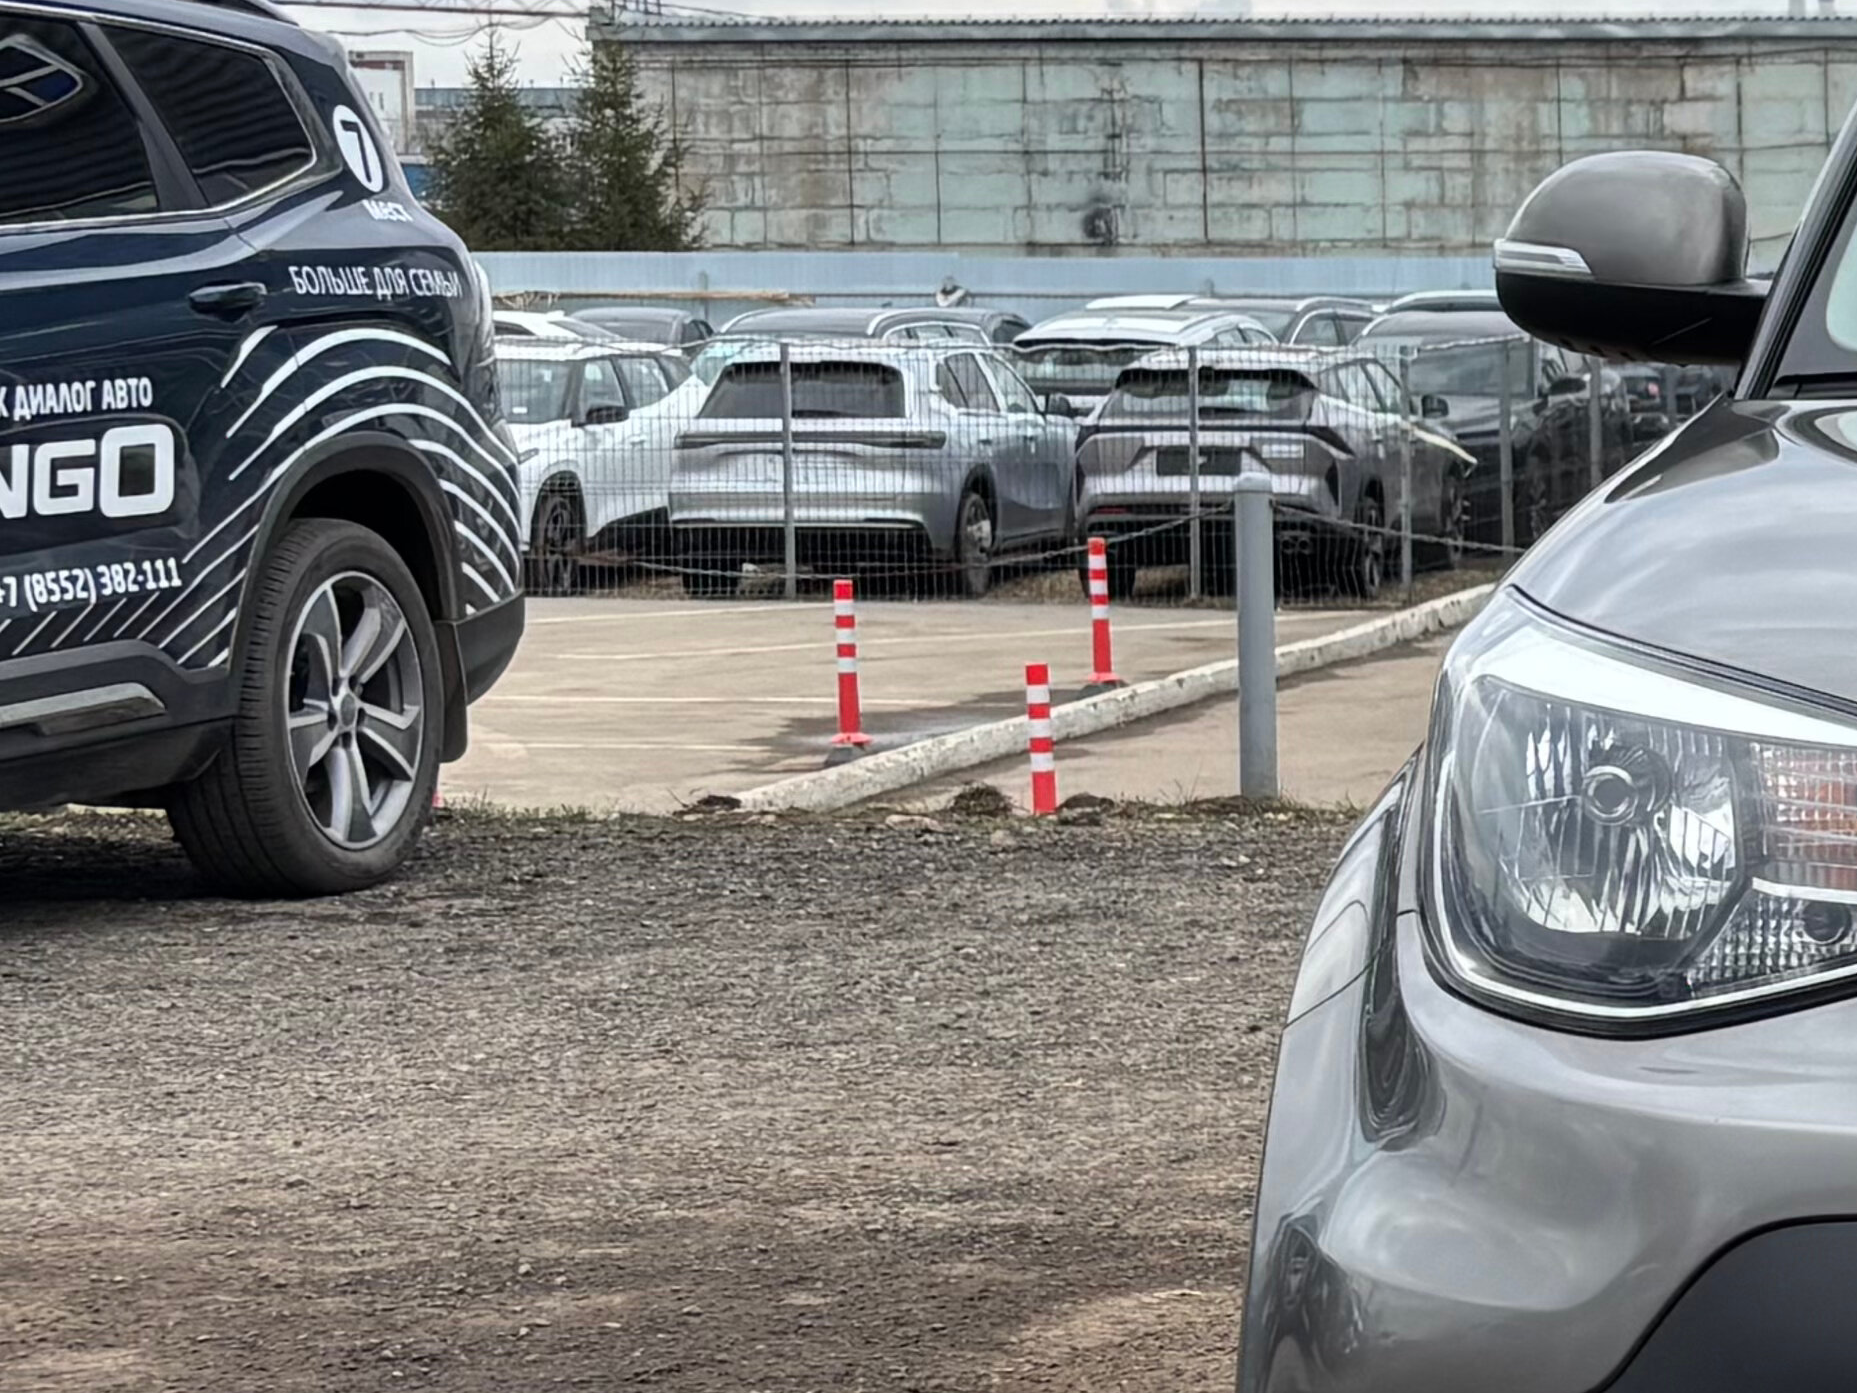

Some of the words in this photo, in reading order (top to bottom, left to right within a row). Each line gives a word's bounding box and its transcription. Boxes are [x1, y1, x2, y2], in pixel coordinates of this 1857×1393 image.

[340, 120, 372, 182] 7
[288, 266, 372, 295] БОЛЬШЕ
[372, 266, 409, 301] ДЛЯ
[409, 268, 462, 298] СЕМЬИ
[14, 380, 96, 421] ДИАЛОГ
[101, 376, 153, 410] АВТО
[24, 568, 96, 612] (8552)
[97, 557, 182, 596] 382-111
